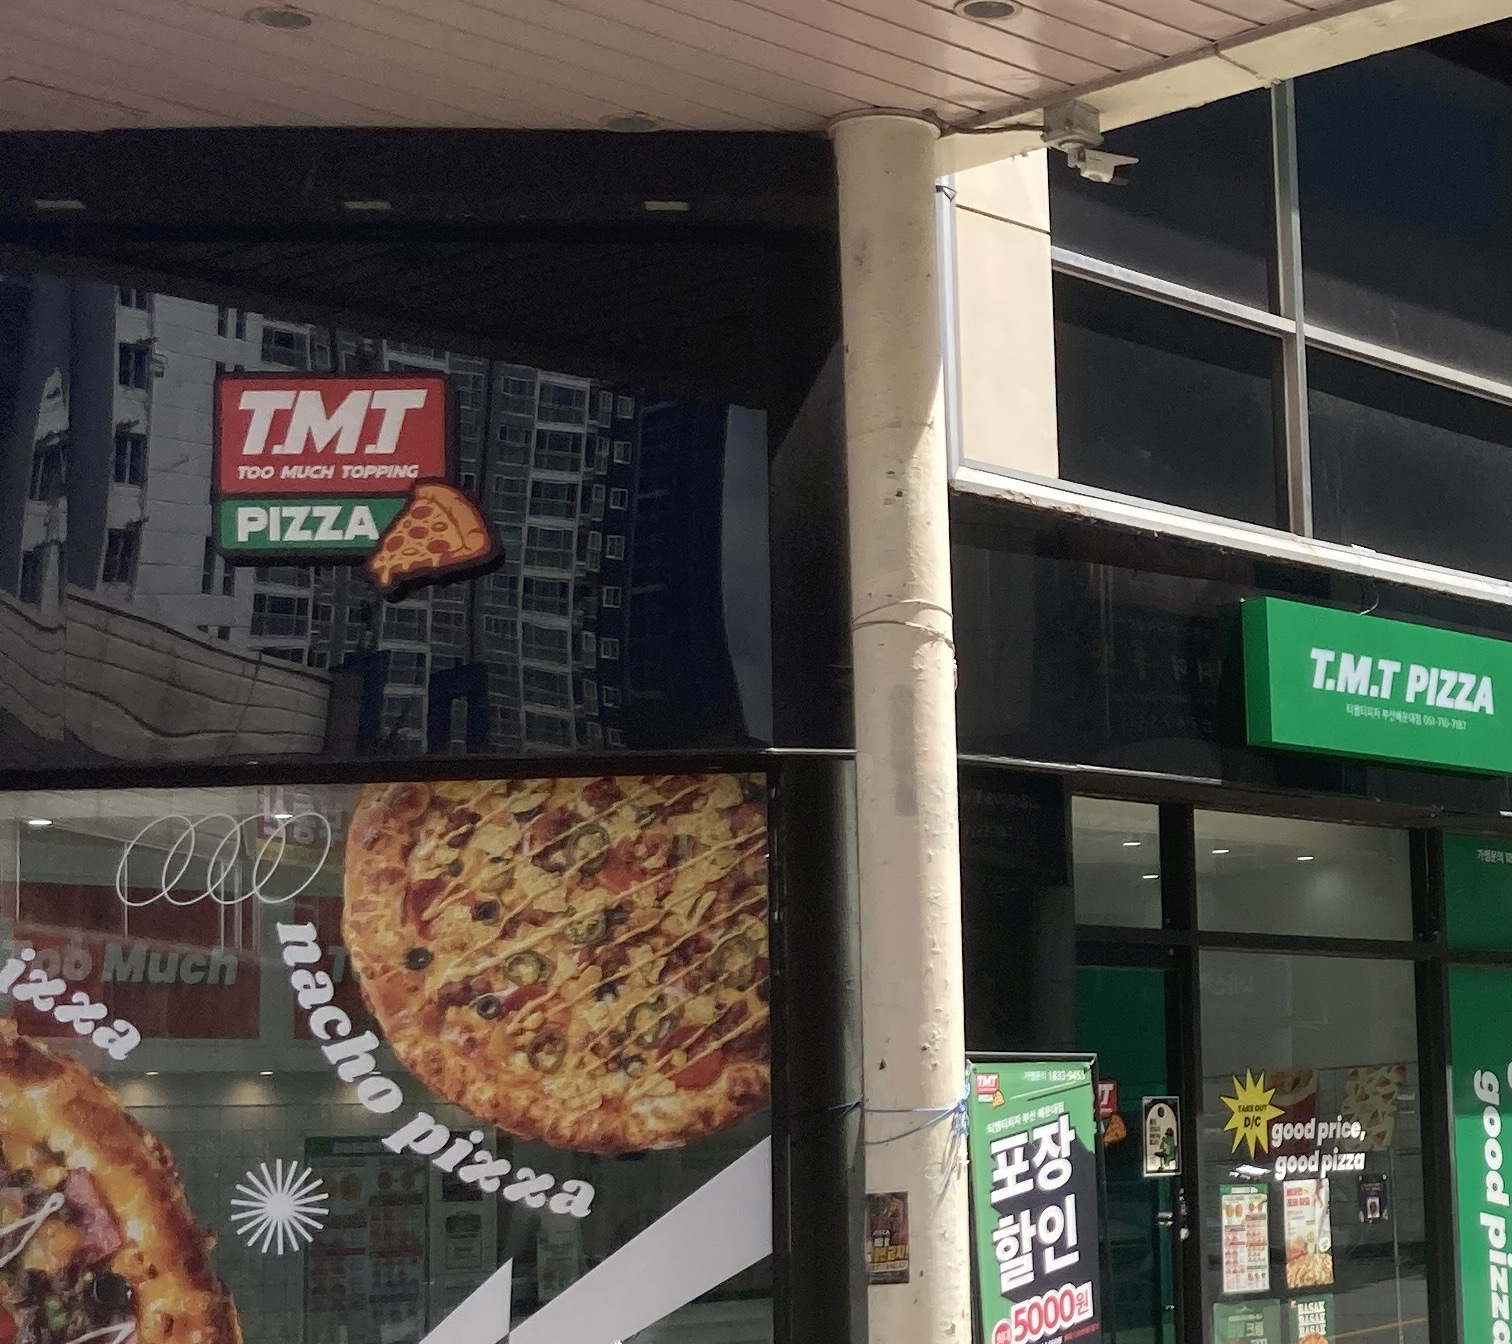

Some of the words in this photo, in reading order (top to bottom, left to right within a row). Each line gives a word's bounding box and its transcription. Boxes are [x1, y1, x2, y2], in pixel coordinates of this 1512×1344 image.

[238, 466, 275, 480] TOO
[280, 465, 336, 480] MUCH
[341, 464, 420, 480] TOPPING
[237, 506, 381, 542] PIZZA
[1310, 647, 1401, 700] T.M.T
[1405, 664, 1494, 715] PIZZA
[104, 943, 240, 985] Much
[276, 921, 403, 1113] nacho
[382, 1111, 595, 1218] pizza
[1243, 1115, 1262, 1130] D/C
[1271, 1117, 1316, 1148] good
[1317, 1114, 1366, 1147] price,
[1473, 1069, 1510, 1206] good
[990, 1113, 1076, 1204] 포장
[1274, 1149, 1319, 1181] good
[1320, 1147, 1366, 1179] pizza
[992, 1193, 1080, 1294] 할인
